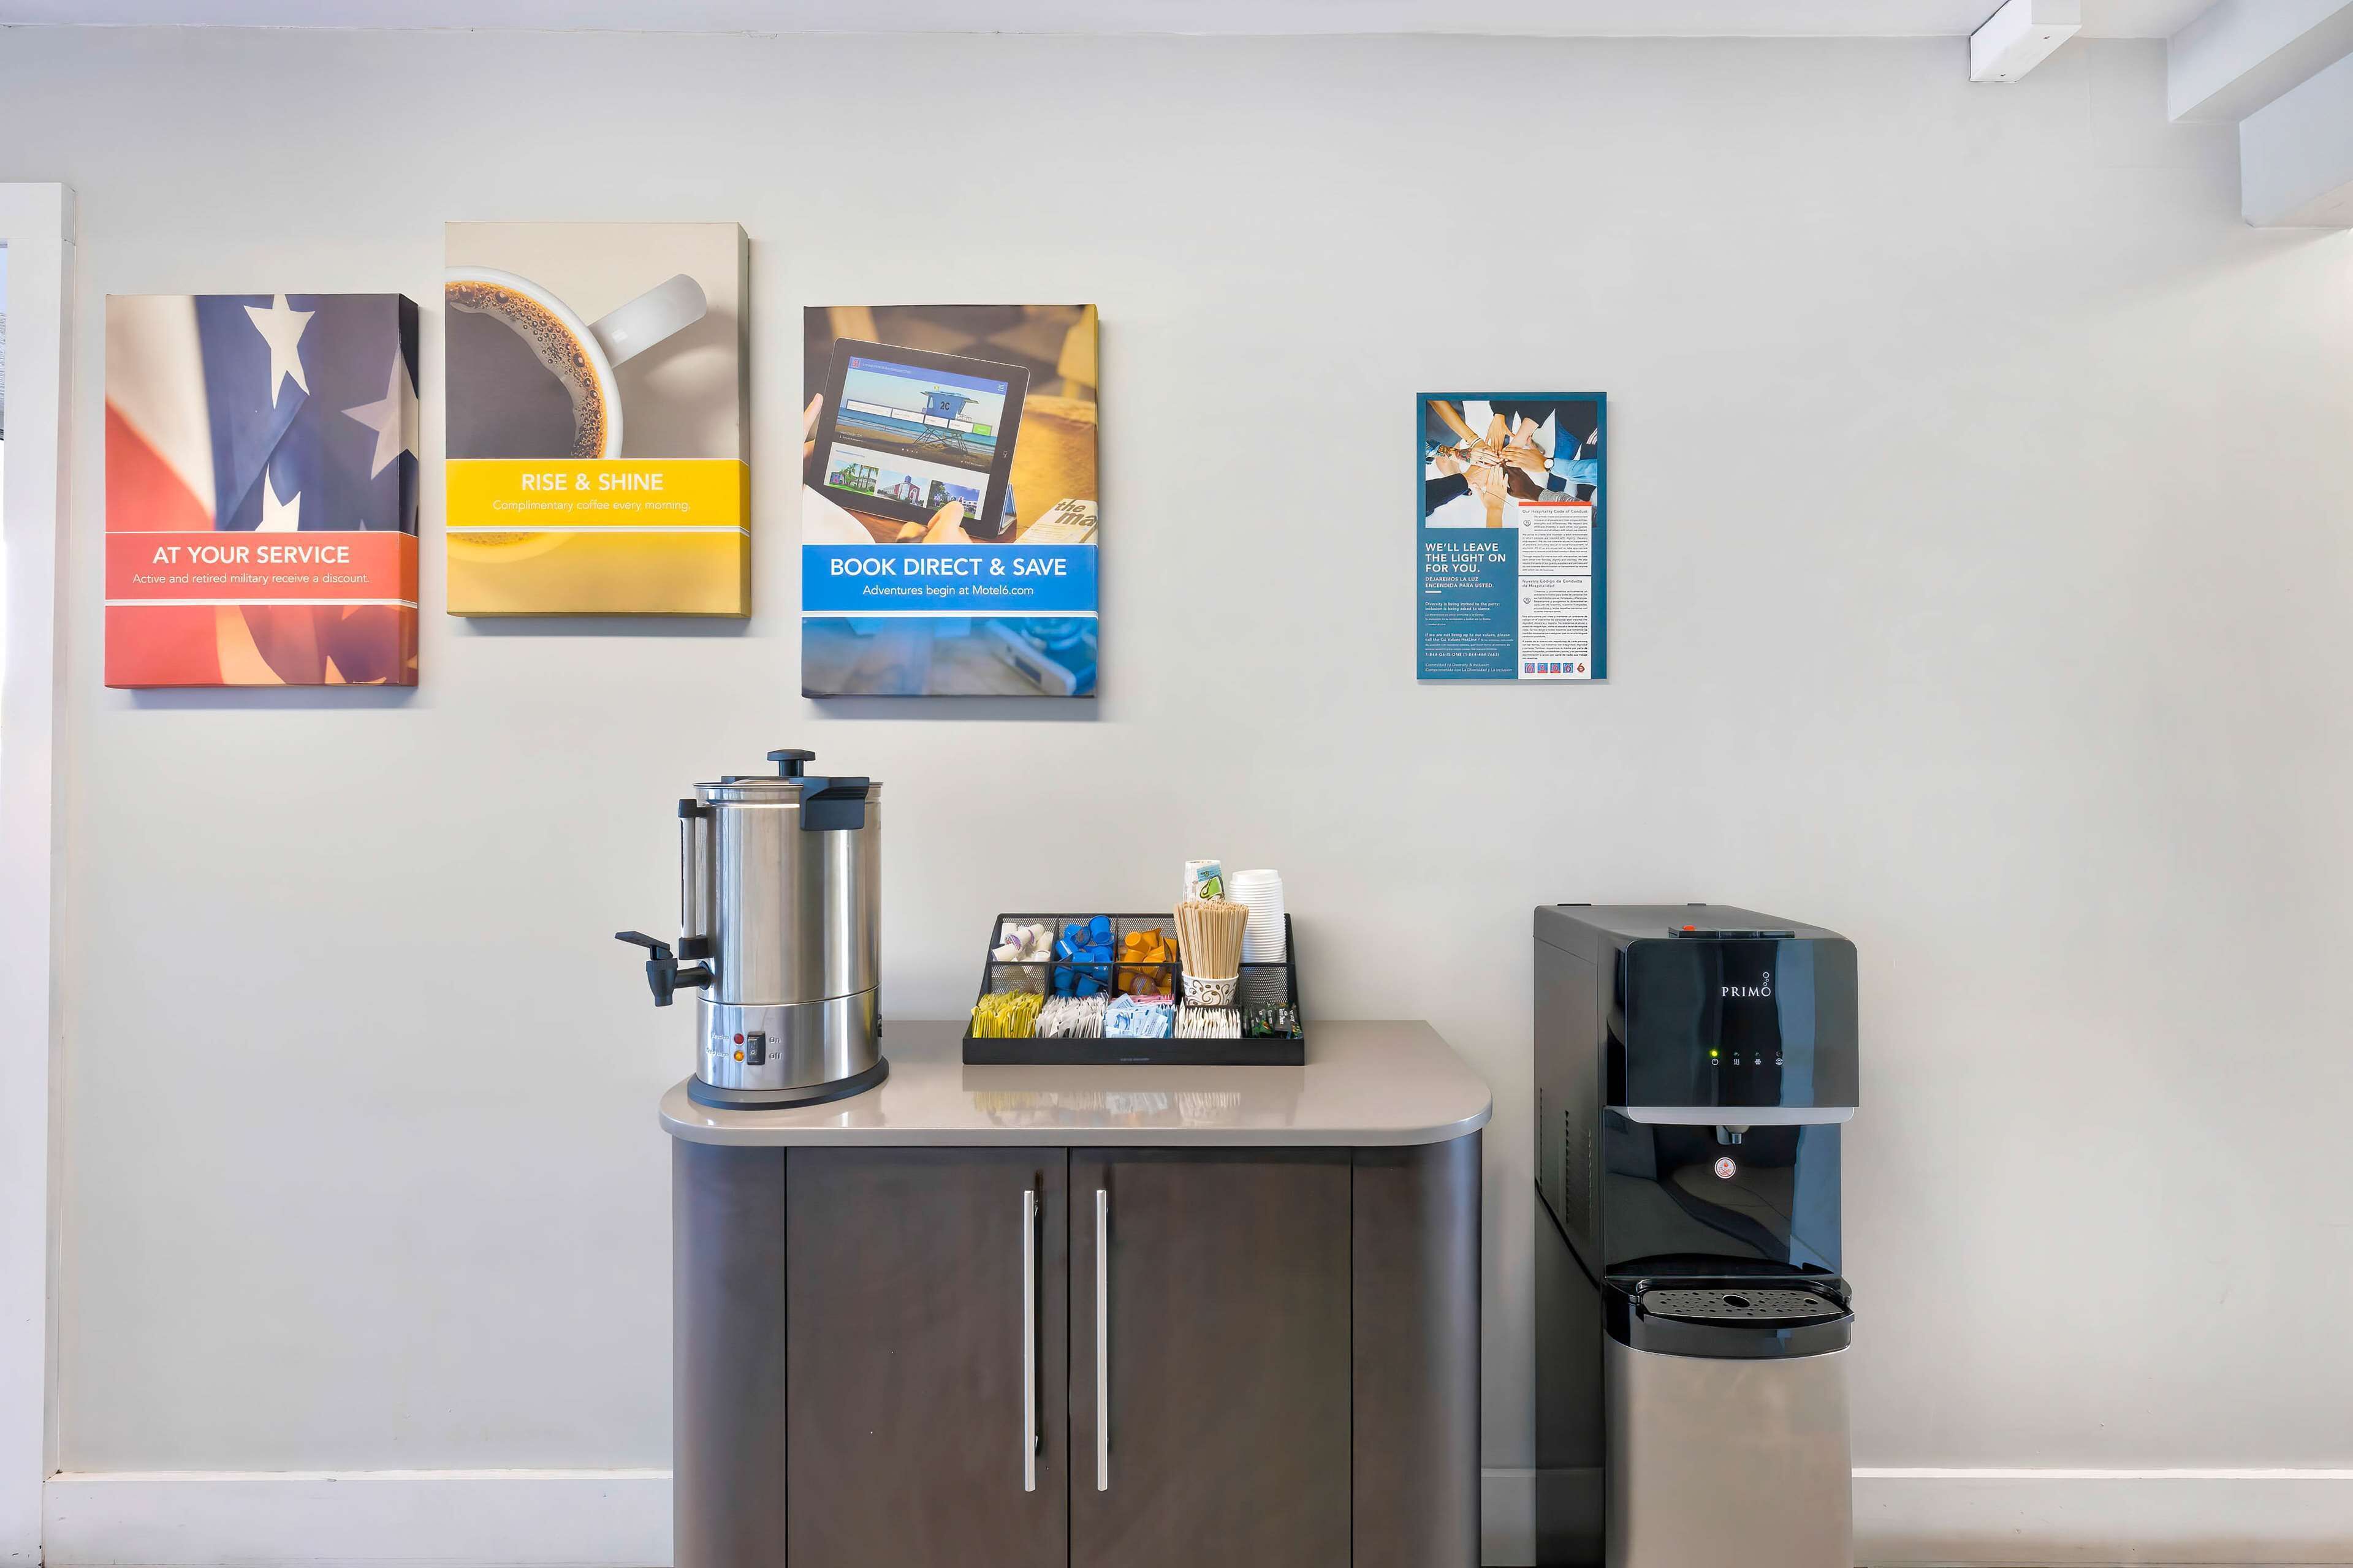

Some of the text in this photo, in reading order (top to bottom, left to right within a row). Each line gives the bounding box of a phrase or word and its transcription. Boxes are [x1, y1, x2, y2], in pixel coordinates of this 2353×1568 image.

[940, 401, 949, 411] 2C
[522, 474, 663, 491] RISE & SHINE
[492, 500, 574, 512] Complimentary
[577, 500, 609, 510] coffee
[613, 502, 642, 512] every
[1055, 500, 1085, 512] the
[1426, 543, 1499, 551] WE'LL LEAVE
[153, 546, 349, 564] AT YOUR SERVICE
[831, 558, 1066, 575] BOOK DIRECT & SAVE
[133, 574, 165, 583] Active
[169, 574, 189, 583] and
[192, 574, 227, 583] retired
[230, 574, 268, 586] military
[272, 574, 310, 583] receive
[322, 574, 369, 583] discount.
[863, 585, 1033, 597] Adventures begin at Motel6.com
[1722, 987, 1771, 997] PRIMO
